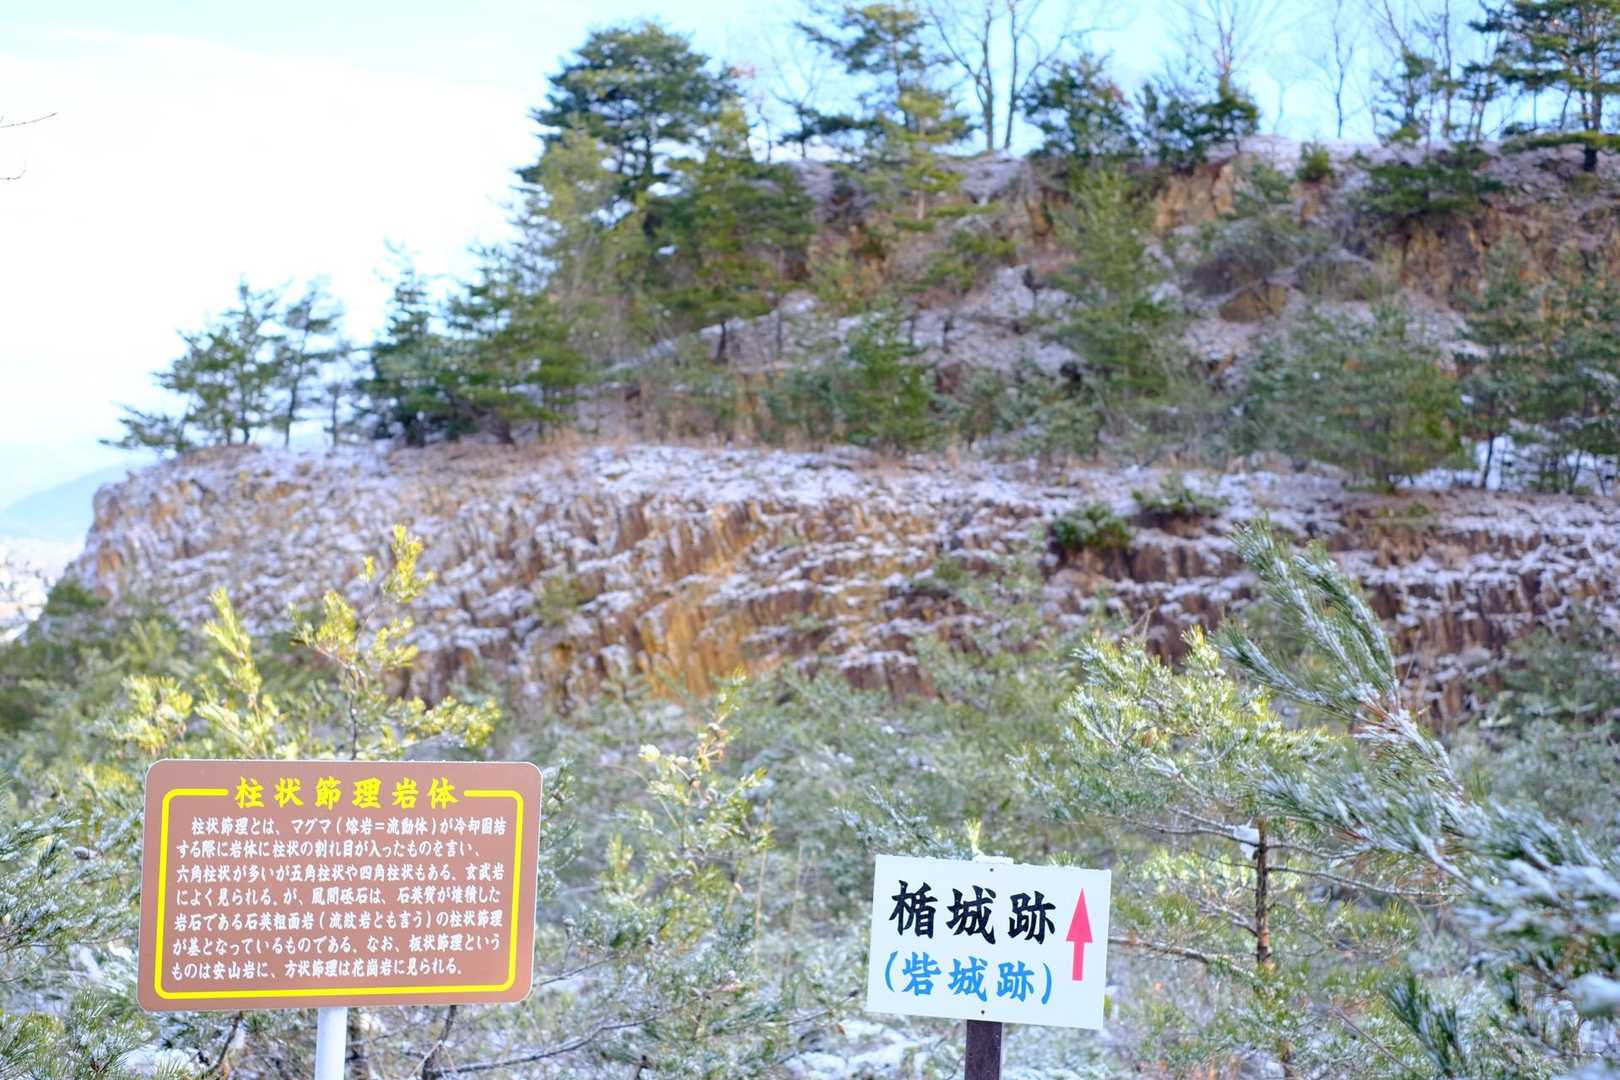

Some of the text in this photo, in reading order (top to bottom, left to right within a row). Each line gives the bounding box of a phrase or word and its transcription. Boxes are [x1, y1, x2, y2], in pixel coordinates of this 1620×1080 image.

[233, 775, 460, 811] 柱状節理岩体
[889, 879, 1057, 945] 楯城跡
[884, 950, 1053, 1005] （砦城跡）
